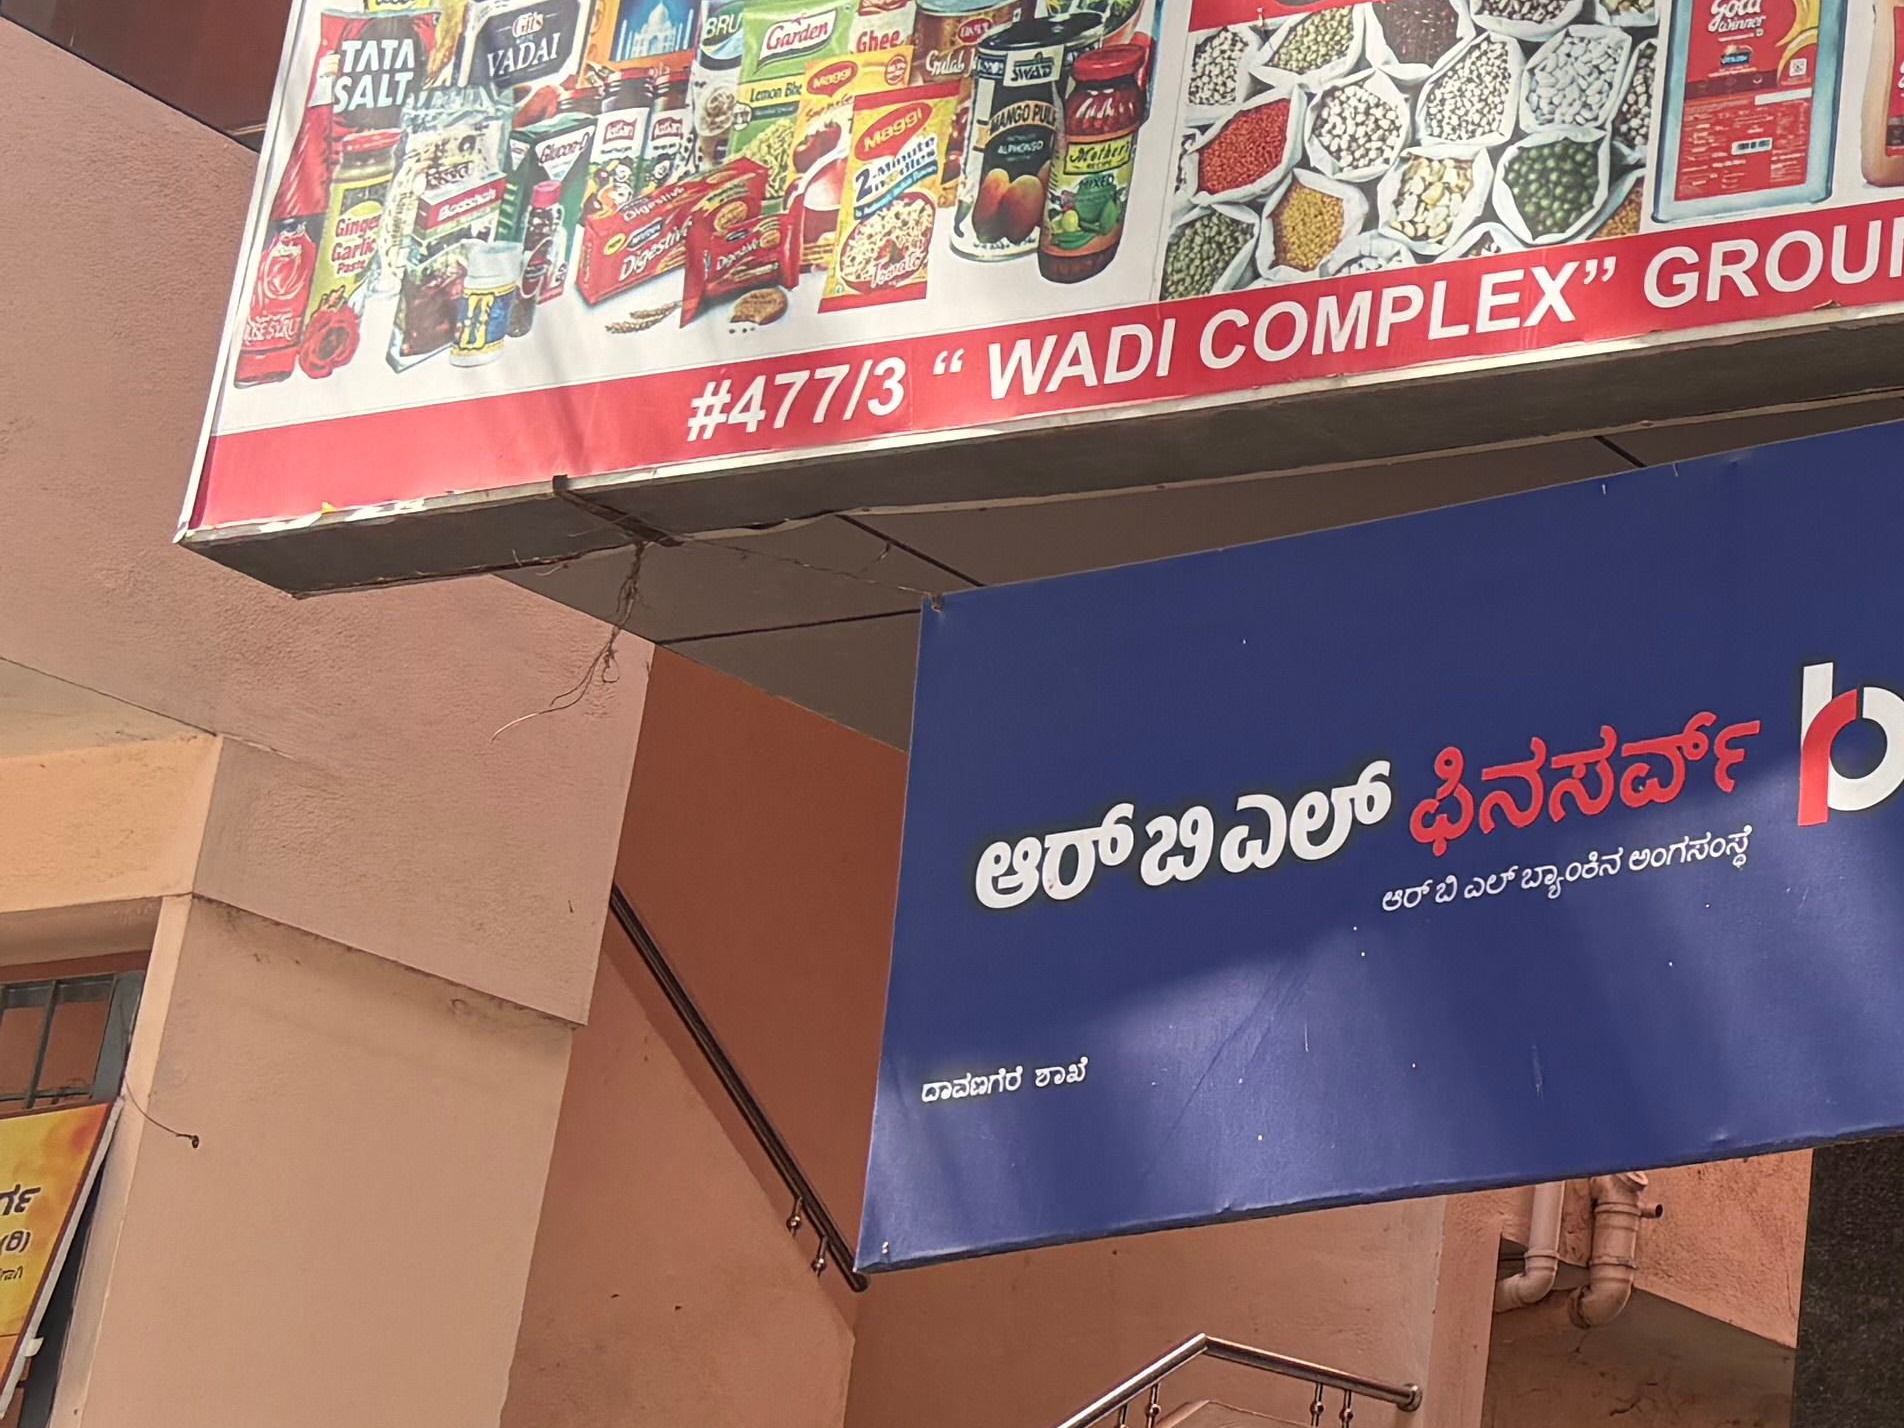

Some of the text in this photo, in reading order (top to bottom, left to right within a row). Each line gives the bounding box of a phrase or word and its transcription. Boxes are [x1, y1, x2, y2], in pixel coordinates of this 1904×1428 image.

[766, 20, 829, 50] Garden
[856, 27, 901, 53] Ghee
[341, 38, 415, 72] TATA
[487, 33, 563, 77] VADAI
[925, 48, 966, 76] Gulab
[334, 72, 414, 113] SALT
[749, 87, 783, 103] Lemon
[863, 108, 923, 151] Maggi
[990, 103, 1030, 130] MANGO
[687, 357, 907, 442] #477/3
[986, 320, 1174, 400] WADI
[921, 1055, 1090, 1105] ದಾವಣಗೆರೆ ಶಾಖೆ
